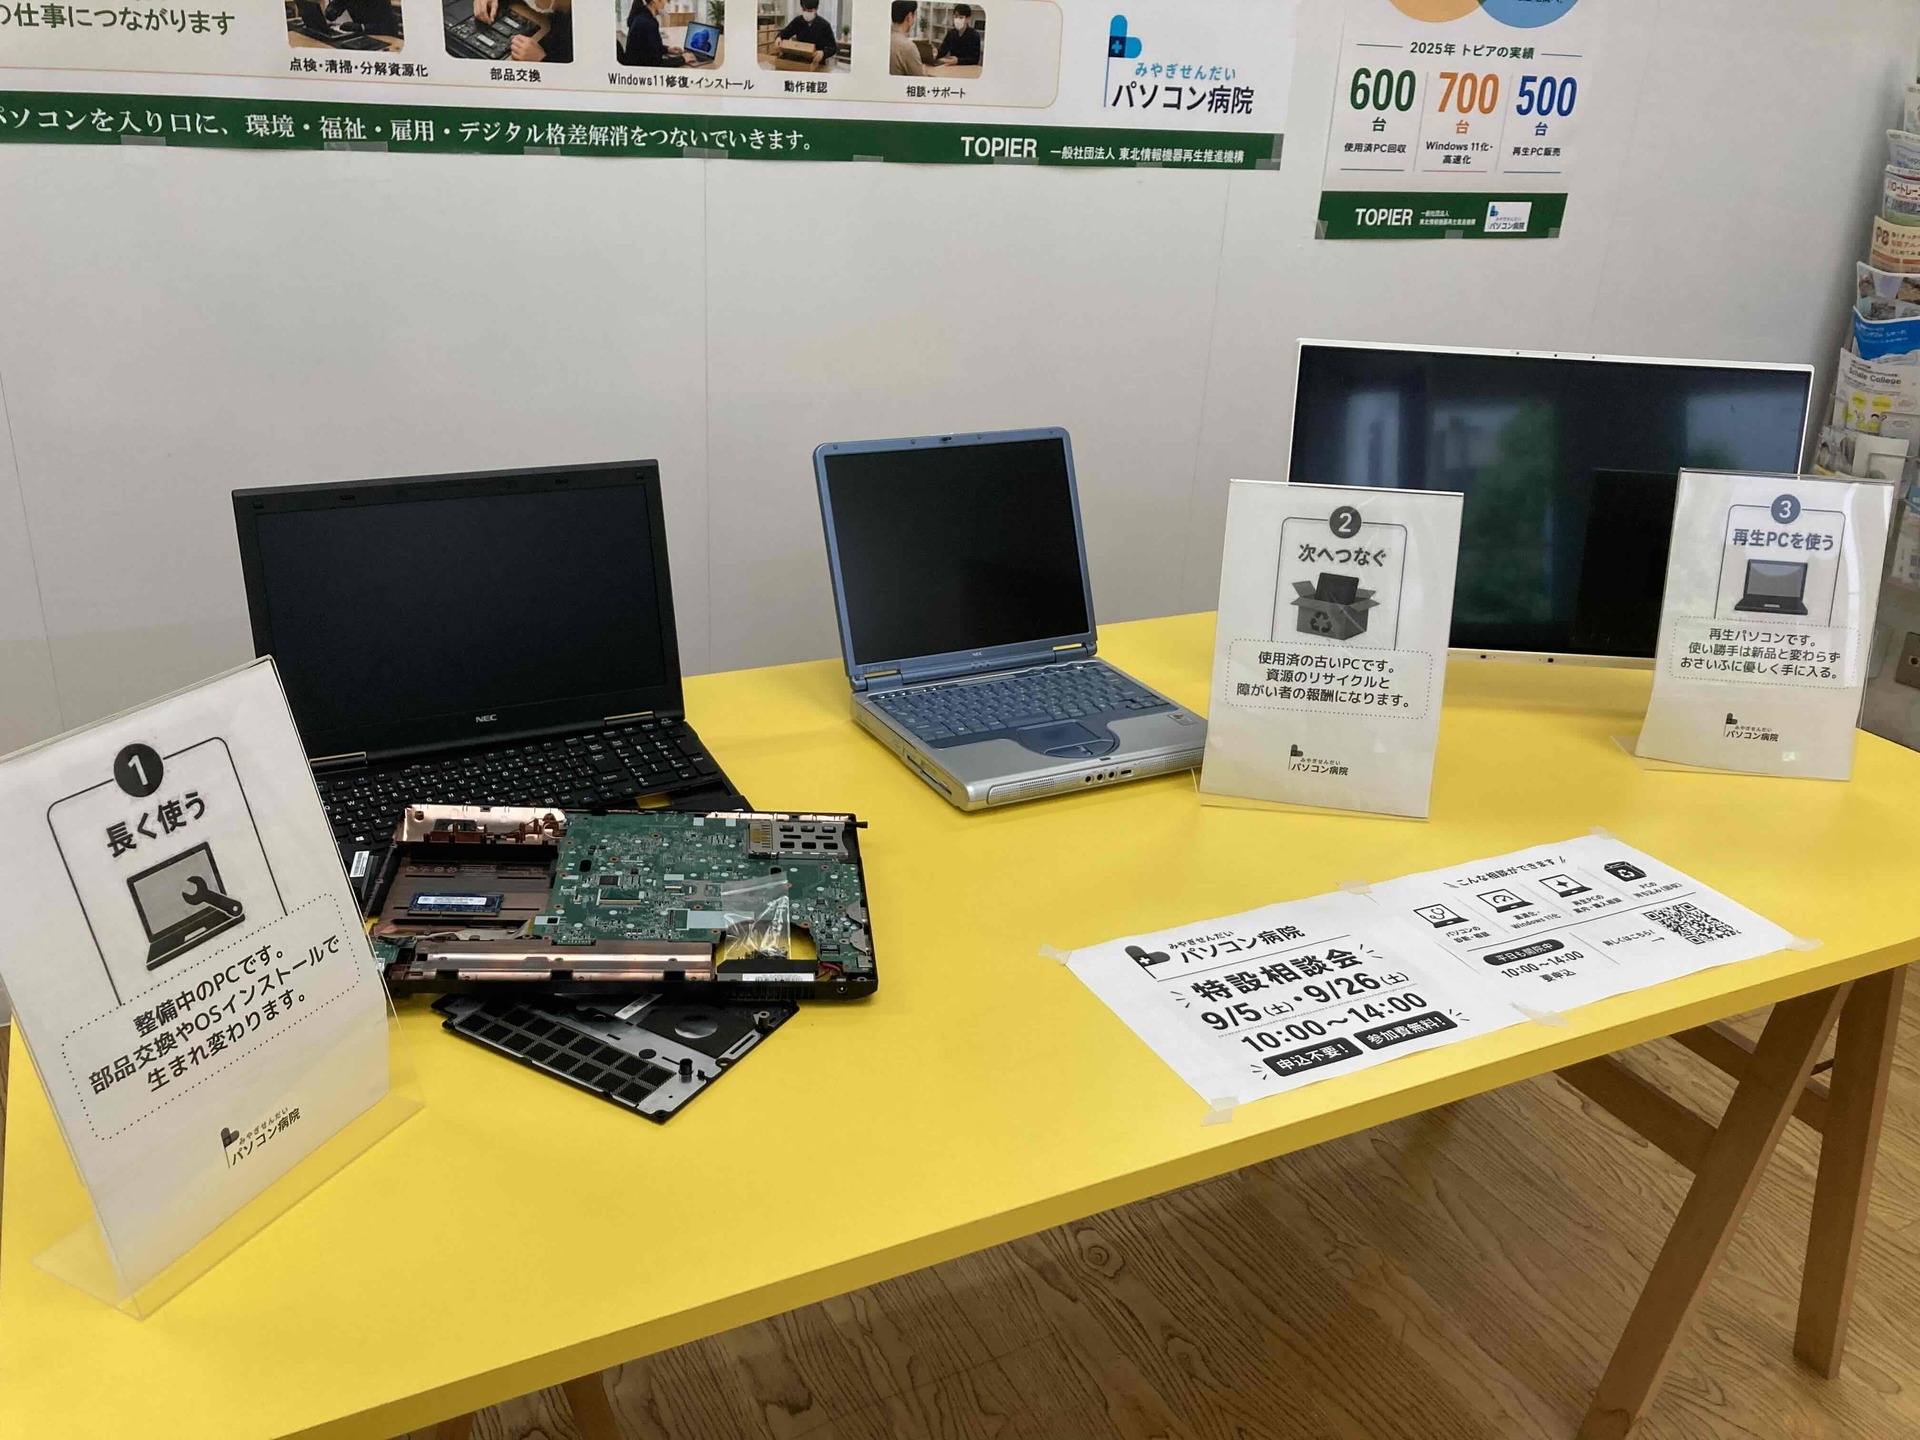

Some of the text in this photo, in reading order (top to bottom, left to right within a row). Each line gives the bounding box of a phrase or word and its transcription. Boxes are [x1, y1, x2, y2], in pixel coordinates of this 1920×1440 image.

[1410, 41, 1535, 60] 2025年 トピアの実績
[289, 57, 429, 77] 点検・清掃・分解資源化
[490, 68, 542, 82] 部品交換
[1135, 62, 1236, 81] みやぎせんだい
[607, 72, 754, 90] Windows11修復・インストール
[784, 80, 828, 93] 動作確認
[906, 85, 966, 98] 相談・サポート
[1350, 67, 1416, 112] 600
[1111, 81, 1254, 114] パソコン病院
[1437, 71, 1499, 115] 700
[1516, 75, 1578, 117] 500
[1372, 117, 1387, 132] 台
[1456, 120, 1470, 134] 台
[1534, 122, 1548, 136] 台
[960, 136, 1244, 164] TOPIER 一般社団法人 東北情報機器再生推進機構
[1343, 142, 1407, 154] 使用済PC回収
[1426, 141, 1468, 151] Windows
[1443, 155, 1472, 165] 高速化
[1355, 208, 1414, 226] TOPIER
[1779, 500, 1792, 518] 3
[1338, 512, 1352, 533] 2
[1732, 528, 1834, 551] 再生PCを使う
[1298, 544, 1387, 567] 次へつなぐ
[1709, 628, 1816, 647] 再生パソコンです。
[1258, 651, 1395, 674] 使用済の古いPCです。
[1688, 641, 1841, 663] 使い勝手は新品と変わらず
[1680, 656, 1838, 679] おさいふに優しく手に入る。
[1266, 668, 1390, 690] 資源のリサイクルと
[1236, 683, 1409, 708] 障がい者の報酬になります。
[475, 713, 498, 723] NEC
[1726, 729, 1779, 742] パソコン病院
[128, 754, 150, 785] 1
[1291, 763, 1349, 776] パソコン病院
[106, 790, 208, 858] 長く使う
[1456, 858, 1555, 886] こんな相談ができます
[1168, 929, 1234, 950] みやぎせんだい
[1180, 925, 1306, 964] パソコン病院
[1190, 947, 1362, 1003] 特設相談会
[133, 944, 285, 1038] 整備中のPCです。
[89, 934, 340, 1095] 部品交換やOSインストールで
[146, 992, 306, 1093] 生まれ変わります。
[231, 1108, 301, 1165] パソコン病院
